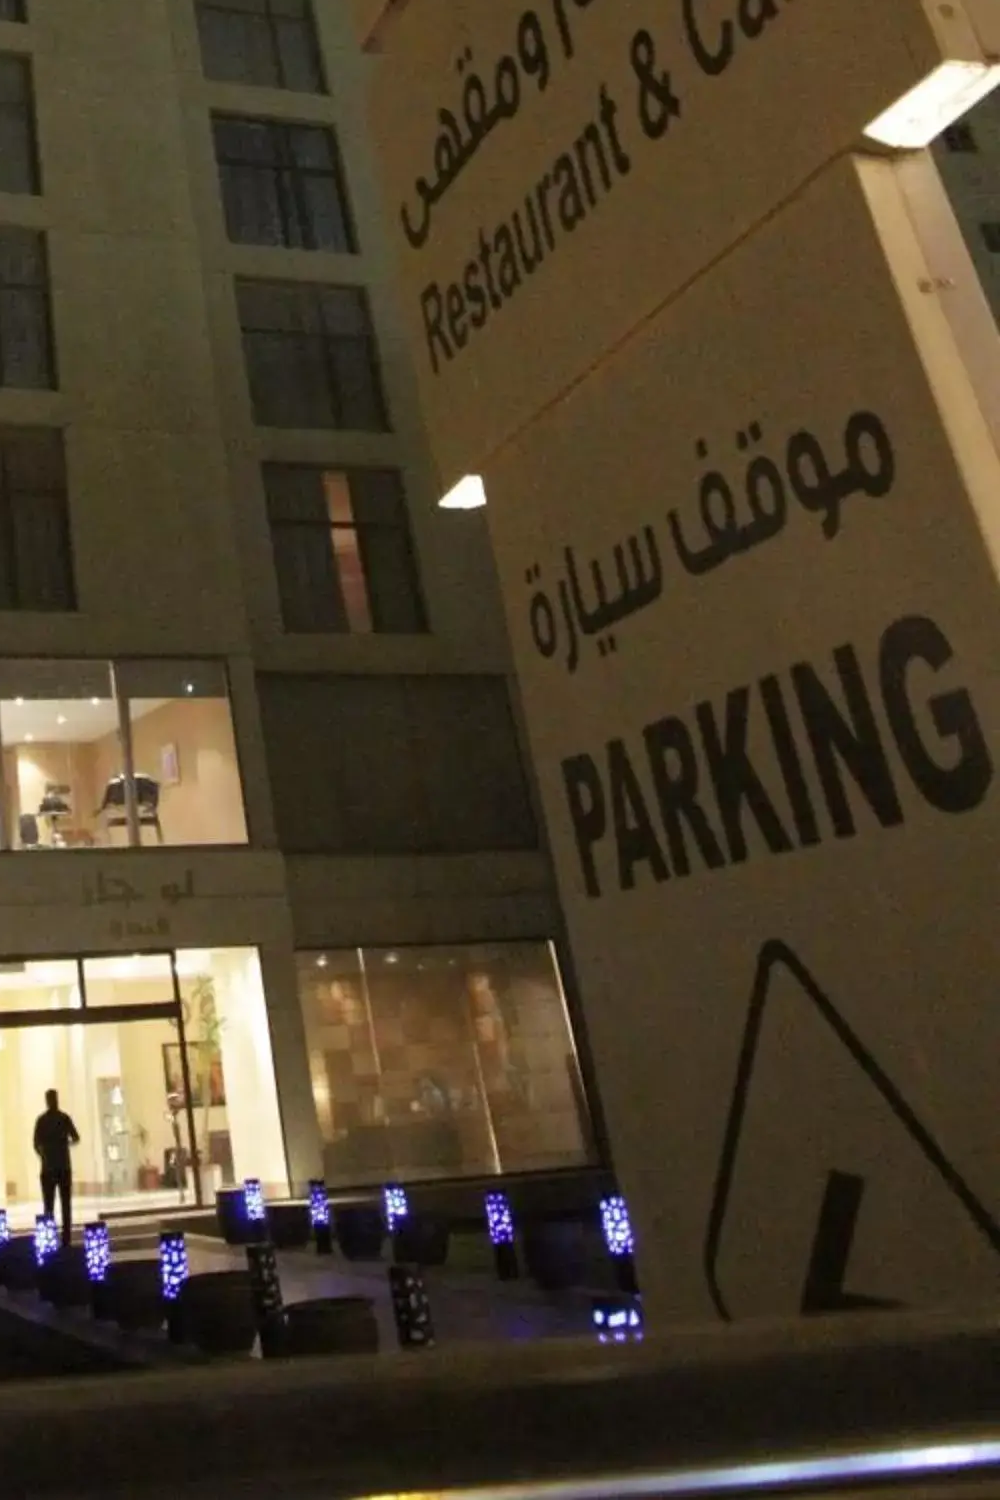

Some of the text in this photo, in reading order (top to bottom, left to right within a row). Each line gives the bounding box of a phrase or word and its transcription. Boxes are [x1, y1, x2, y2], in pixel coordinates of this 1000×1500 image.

[419, 83, 632, 375] Restaurant
[629, 27, 681, 141] &
[523, 409, 896, 674] موقف سيارة
[561, 614, 993, 899] PARKING
